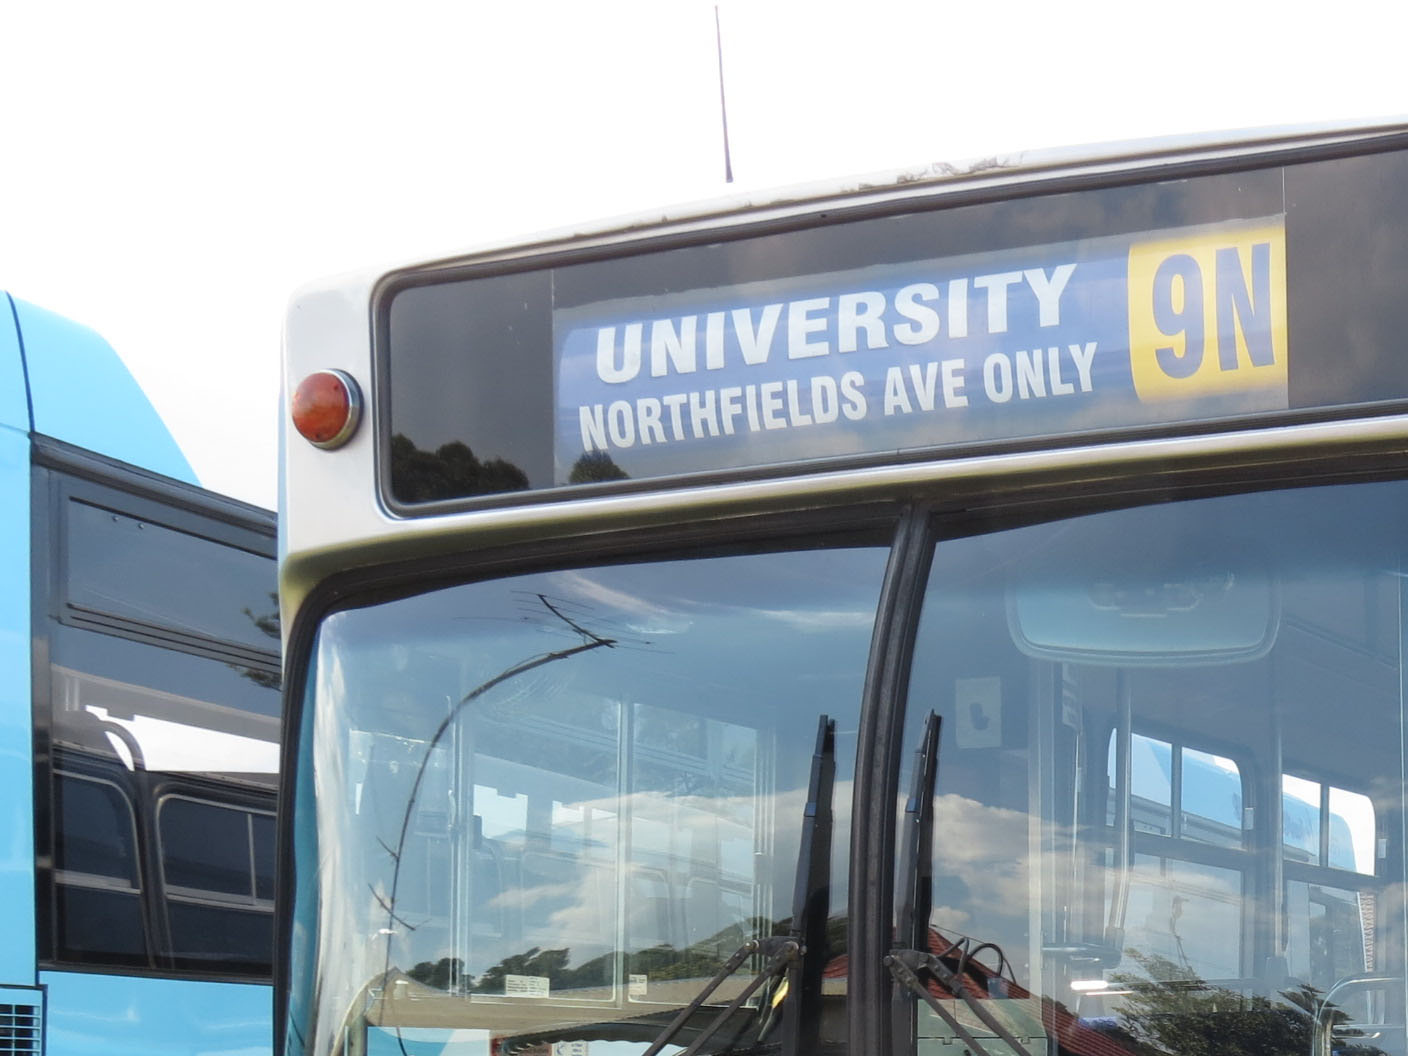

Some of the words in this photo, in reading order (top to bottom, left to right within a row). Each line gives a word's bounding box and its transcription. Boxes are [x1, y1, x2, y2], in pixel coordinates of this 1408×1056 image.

[596, 263, 1077, 384] UNIVERSITY
[1152, 243, 1275, 379] 9N
[578, 371, 867, 452] NORTHFIELDS
[884, 358, 968, 417] AVE
[983, 341, 1098, 403] ONLY
